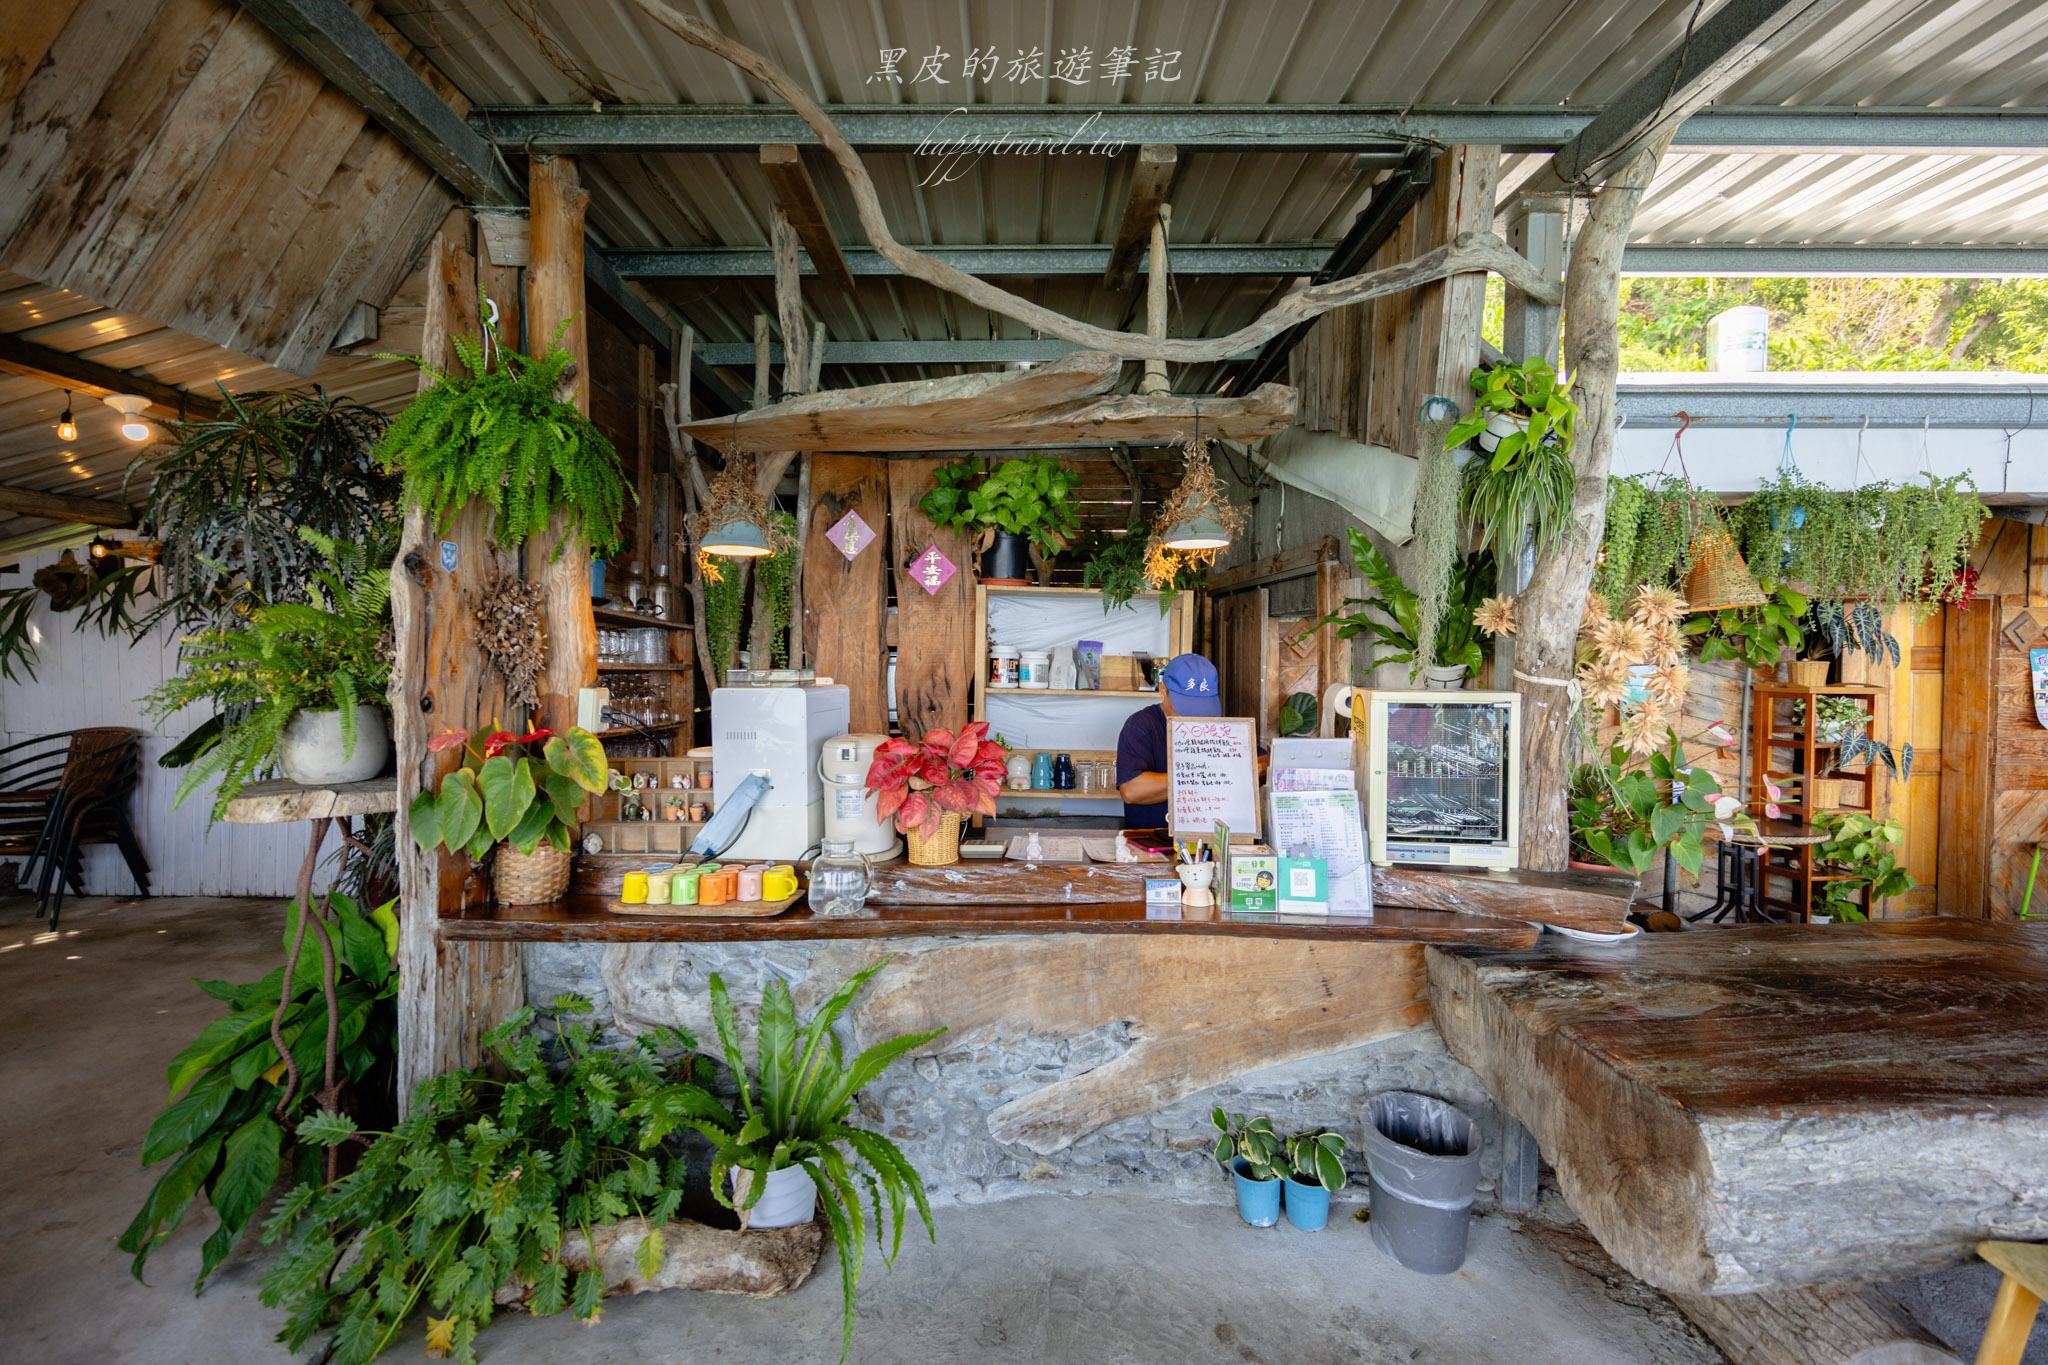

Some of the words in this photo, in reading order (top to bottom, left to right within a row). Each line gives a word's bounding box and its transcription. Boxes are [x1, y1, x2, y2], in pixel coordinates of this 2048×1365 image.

[922, 551, 943, 587] 平安福
[1185, 677, 1211, 692] 多良
[1175, 722, 1238, 739] 今日限定
